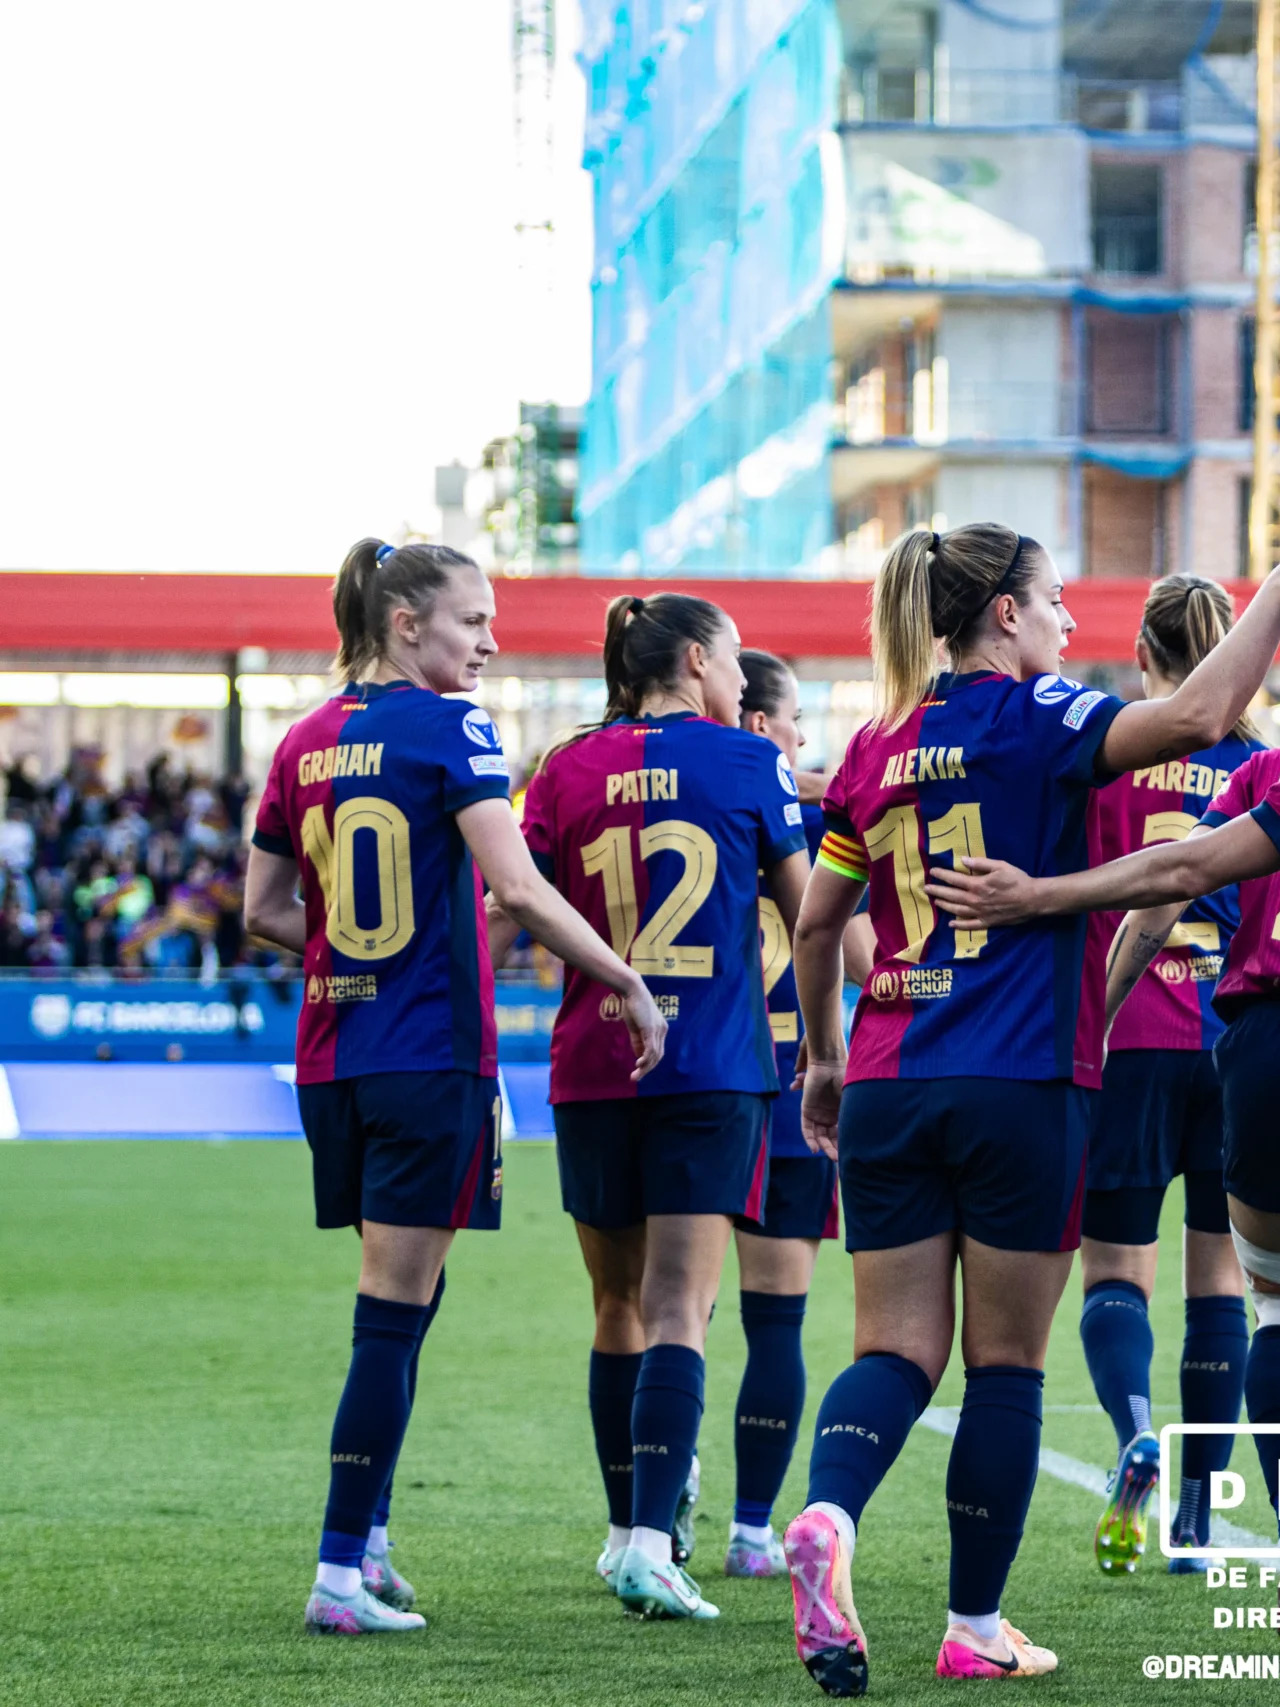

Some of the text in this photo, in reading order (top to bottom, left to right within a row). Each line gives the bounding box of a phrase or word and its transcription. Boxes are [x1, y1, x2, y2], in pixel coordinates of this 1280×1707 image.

[298, 743, 384, 786] GRAHAM
[879, 746, 966, 790] ALEXIA
[606, 768, 678, 806] PATRI
[301, 797, 415, 961] 10
[580, 820, 718, 978] 12
[863, 803, 989, 962] 11
[325, 975, 376, 987] UNHCR
[327, 985, 377, 999] ACNUR
[902, 968, 953, 982] UNHCR
[902, 980, 952, 995] ACNUR
